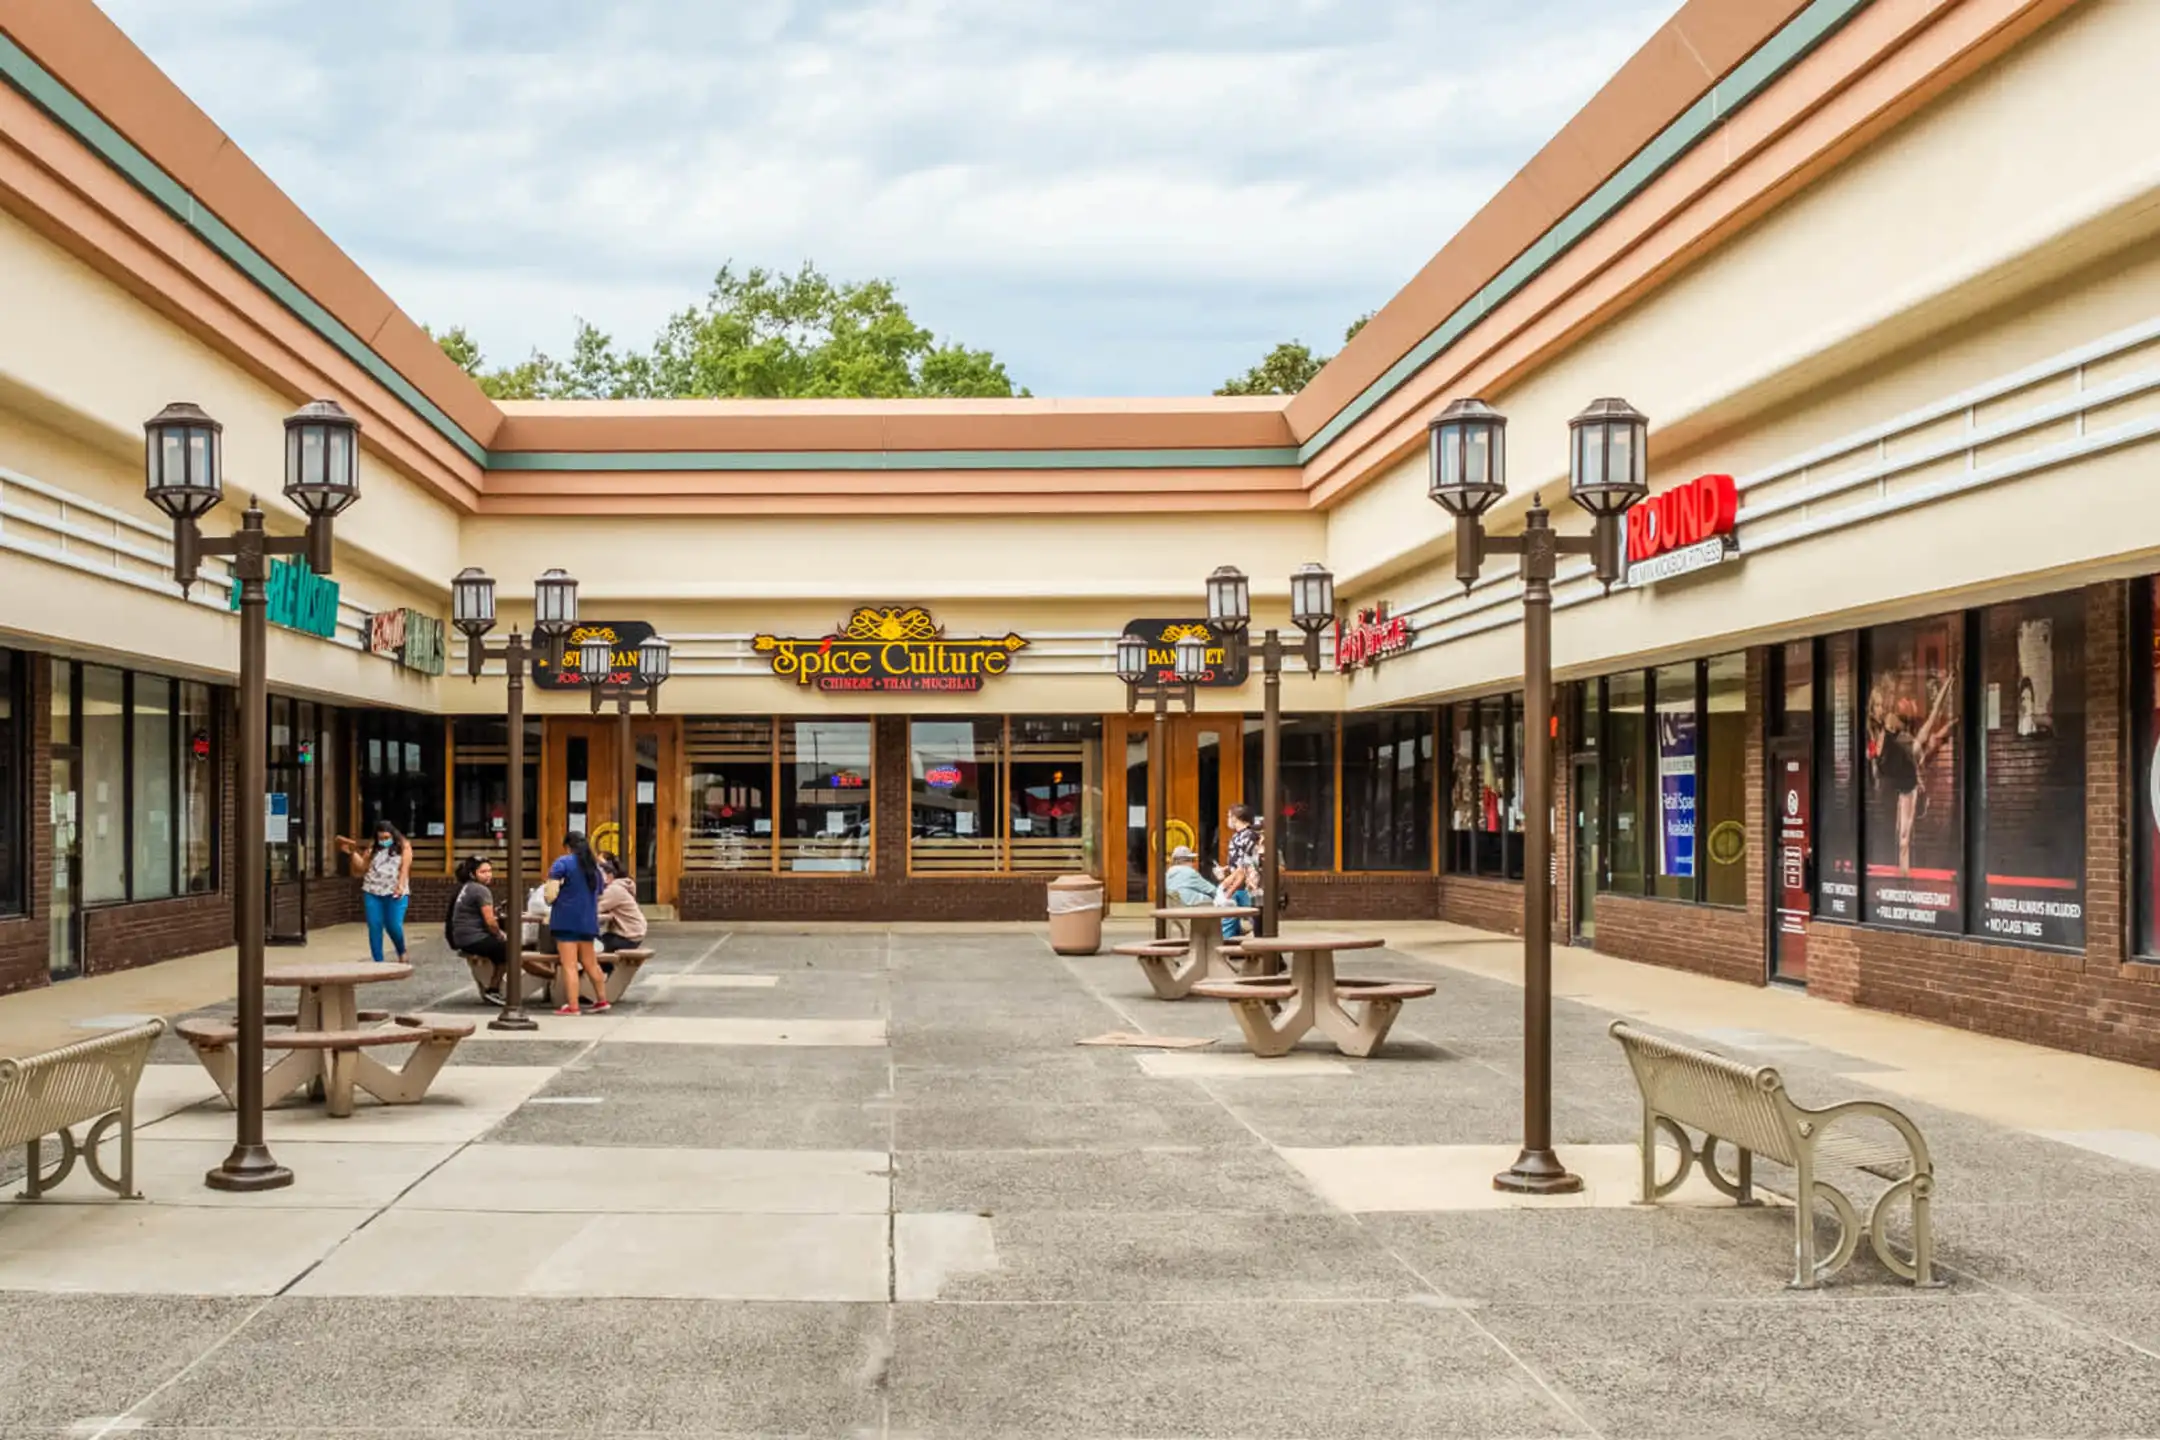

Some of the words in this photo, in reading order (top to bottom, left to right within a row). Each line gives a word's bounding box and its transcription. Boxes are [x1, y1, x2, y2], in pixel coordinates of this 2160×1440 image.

[1627, 474, 1737, 562] ROUND
[773, 642, 872, 684] Spice
[880, 642, 1007, 674] Culture
[821, 677, 873, 690] CHINESE
[883, 677, 912, 690] THAI
[2016, 900, 2045, 915] ALWAYS
[2045, 902, 2081, 918] INCLUDED
[1990, 919, 2001, 931] NO
[2002, 920, 2022, 934] CLASS
